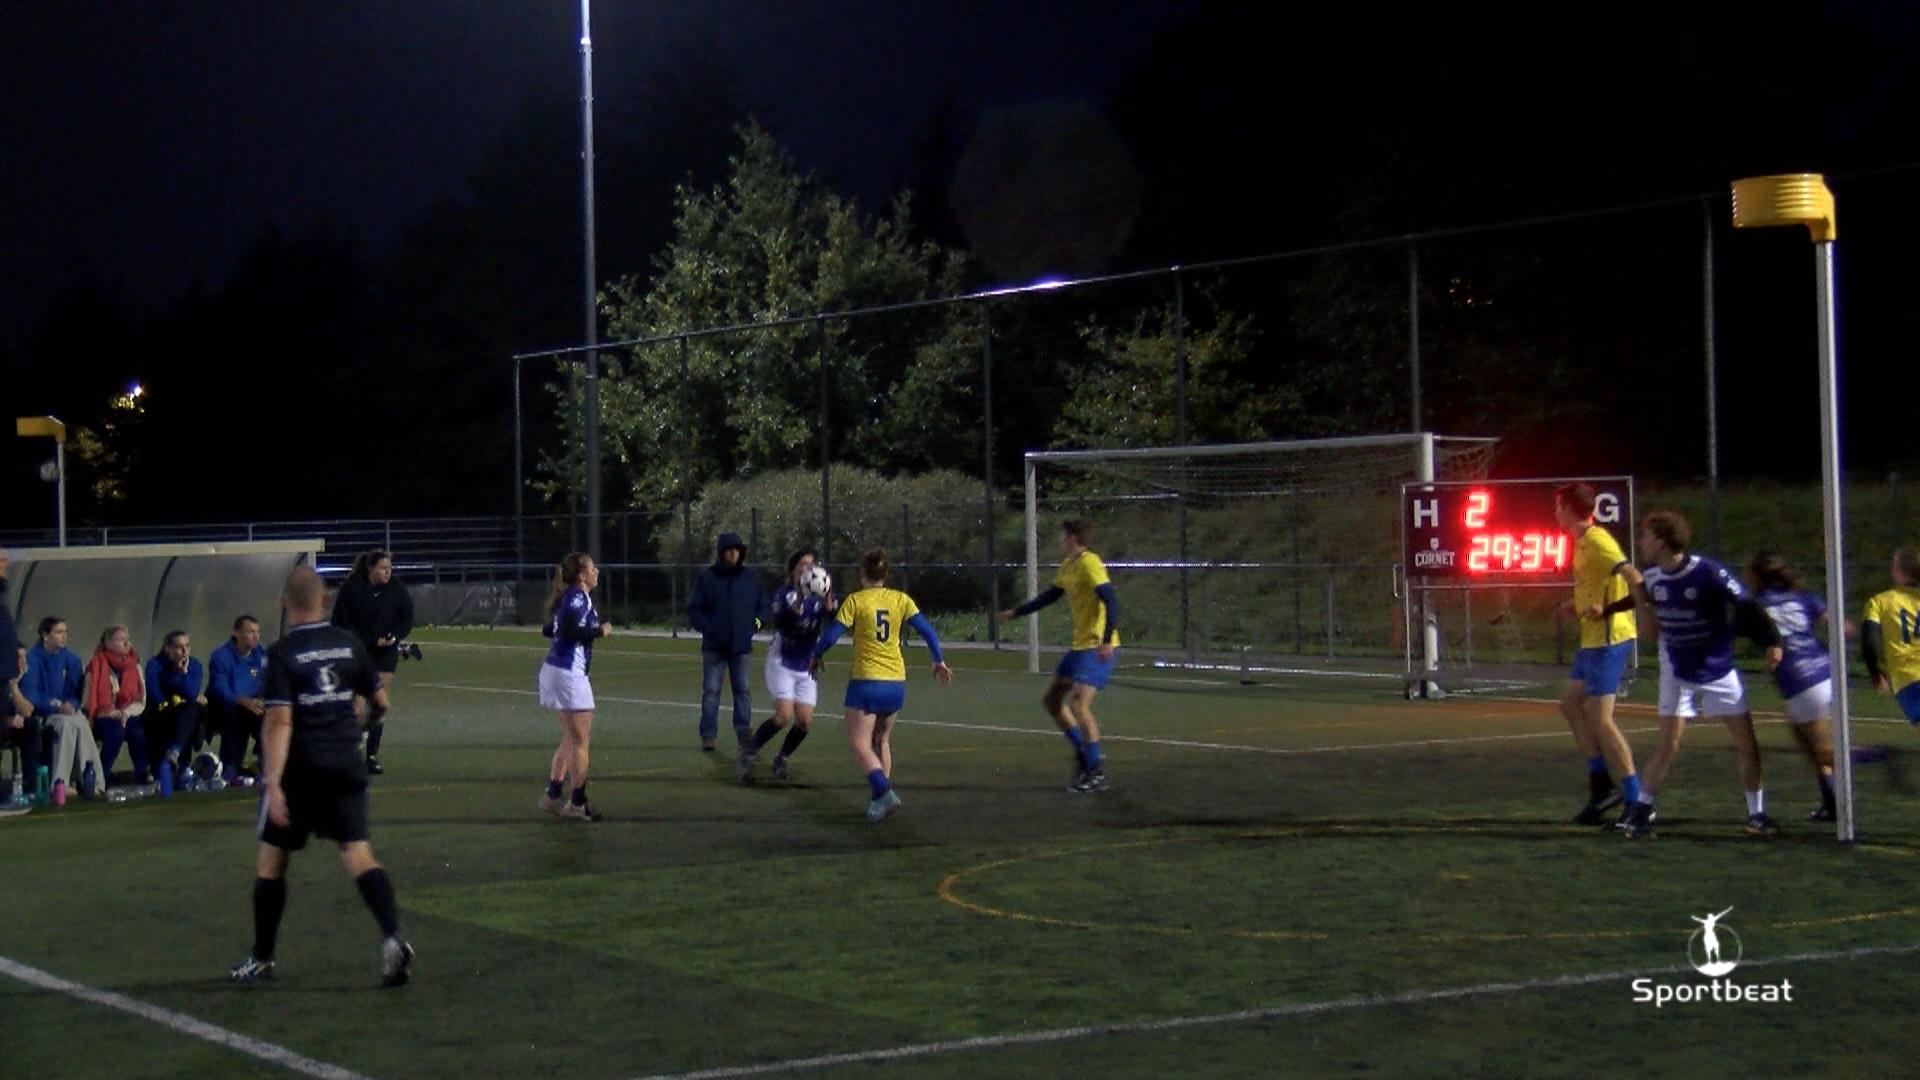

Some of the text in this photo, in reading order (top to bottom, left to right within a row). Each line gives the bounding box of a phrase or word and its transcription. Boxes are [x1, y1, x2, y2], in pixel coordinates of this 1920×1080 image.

[1413, 499, 1439, 528] H
[1465, 494, 1490, 528] 2
[1594, 492, 1620, 523] G
[1414, 551, 1455, 567] CORNET
[1469, 534, 1568, 571] 29:34
[875, 609, 890, 642] 5
